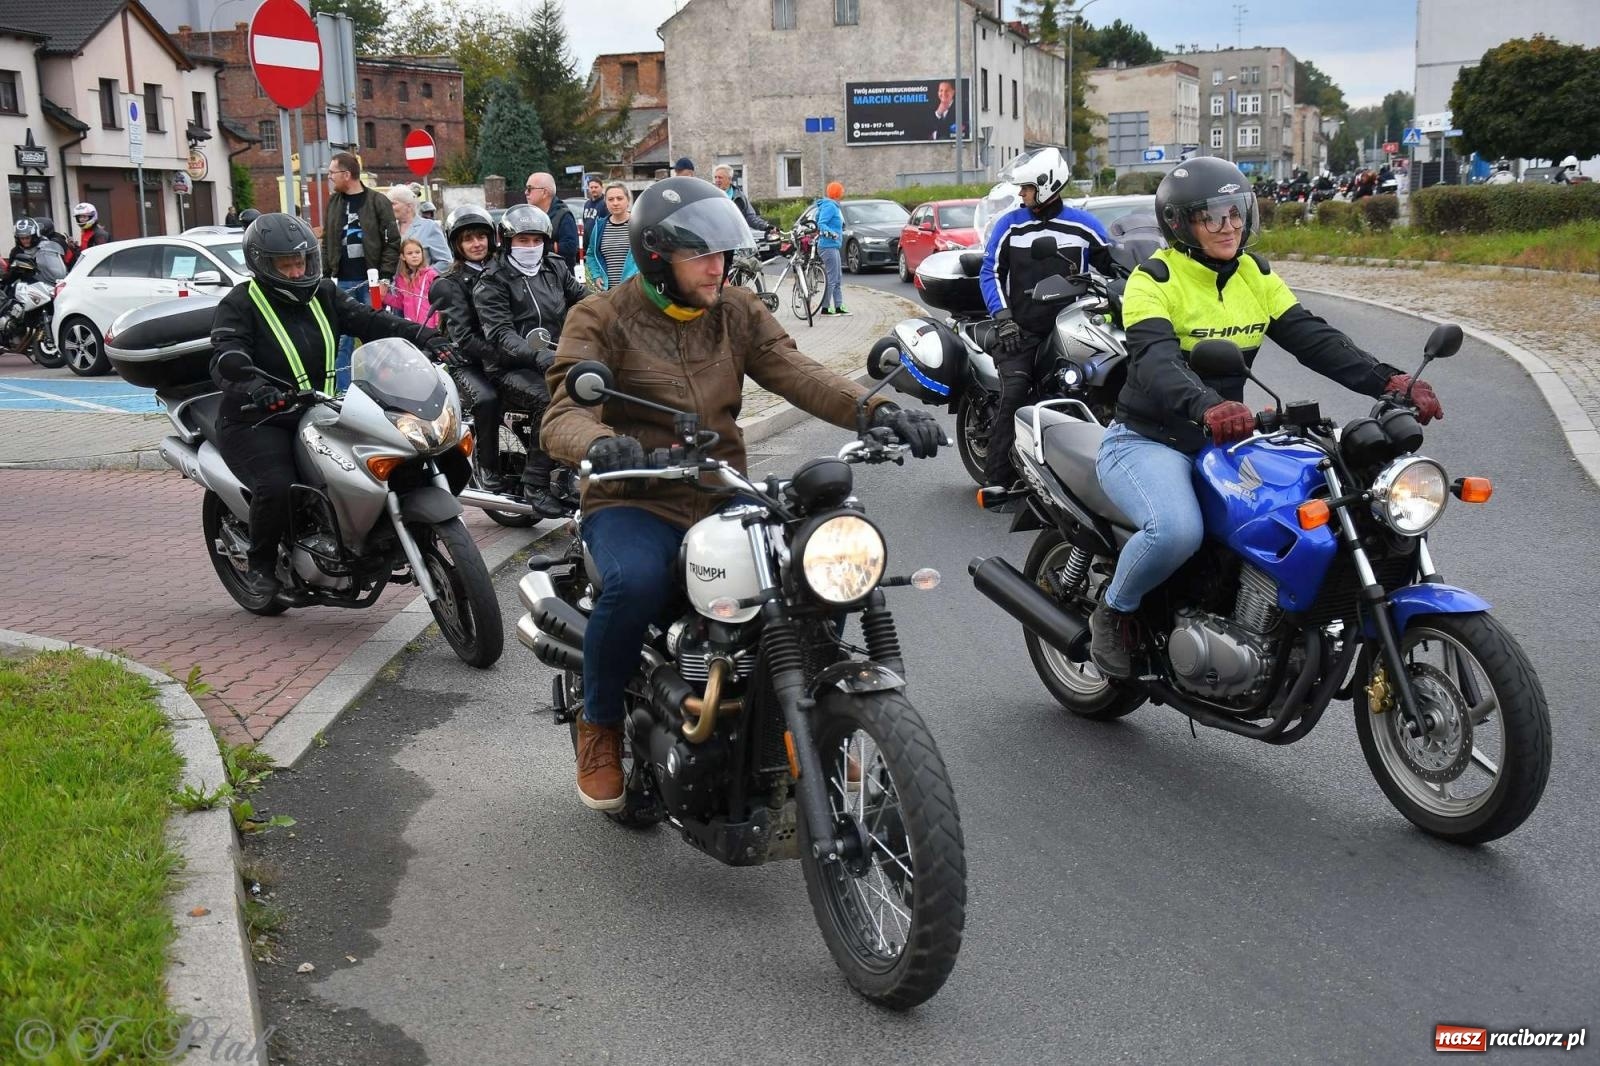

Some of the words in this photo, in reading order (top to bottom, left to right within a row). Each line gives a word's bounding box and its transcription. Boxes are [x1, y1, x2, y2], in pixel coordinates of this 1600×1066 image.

[853, 95, 891, 104] MARCIN
[894, 94, 929, 103] CHMIEL
[1189, 323, 1266, 338] SHIMA
[689, 562, 726, 579] TRIUMPH
